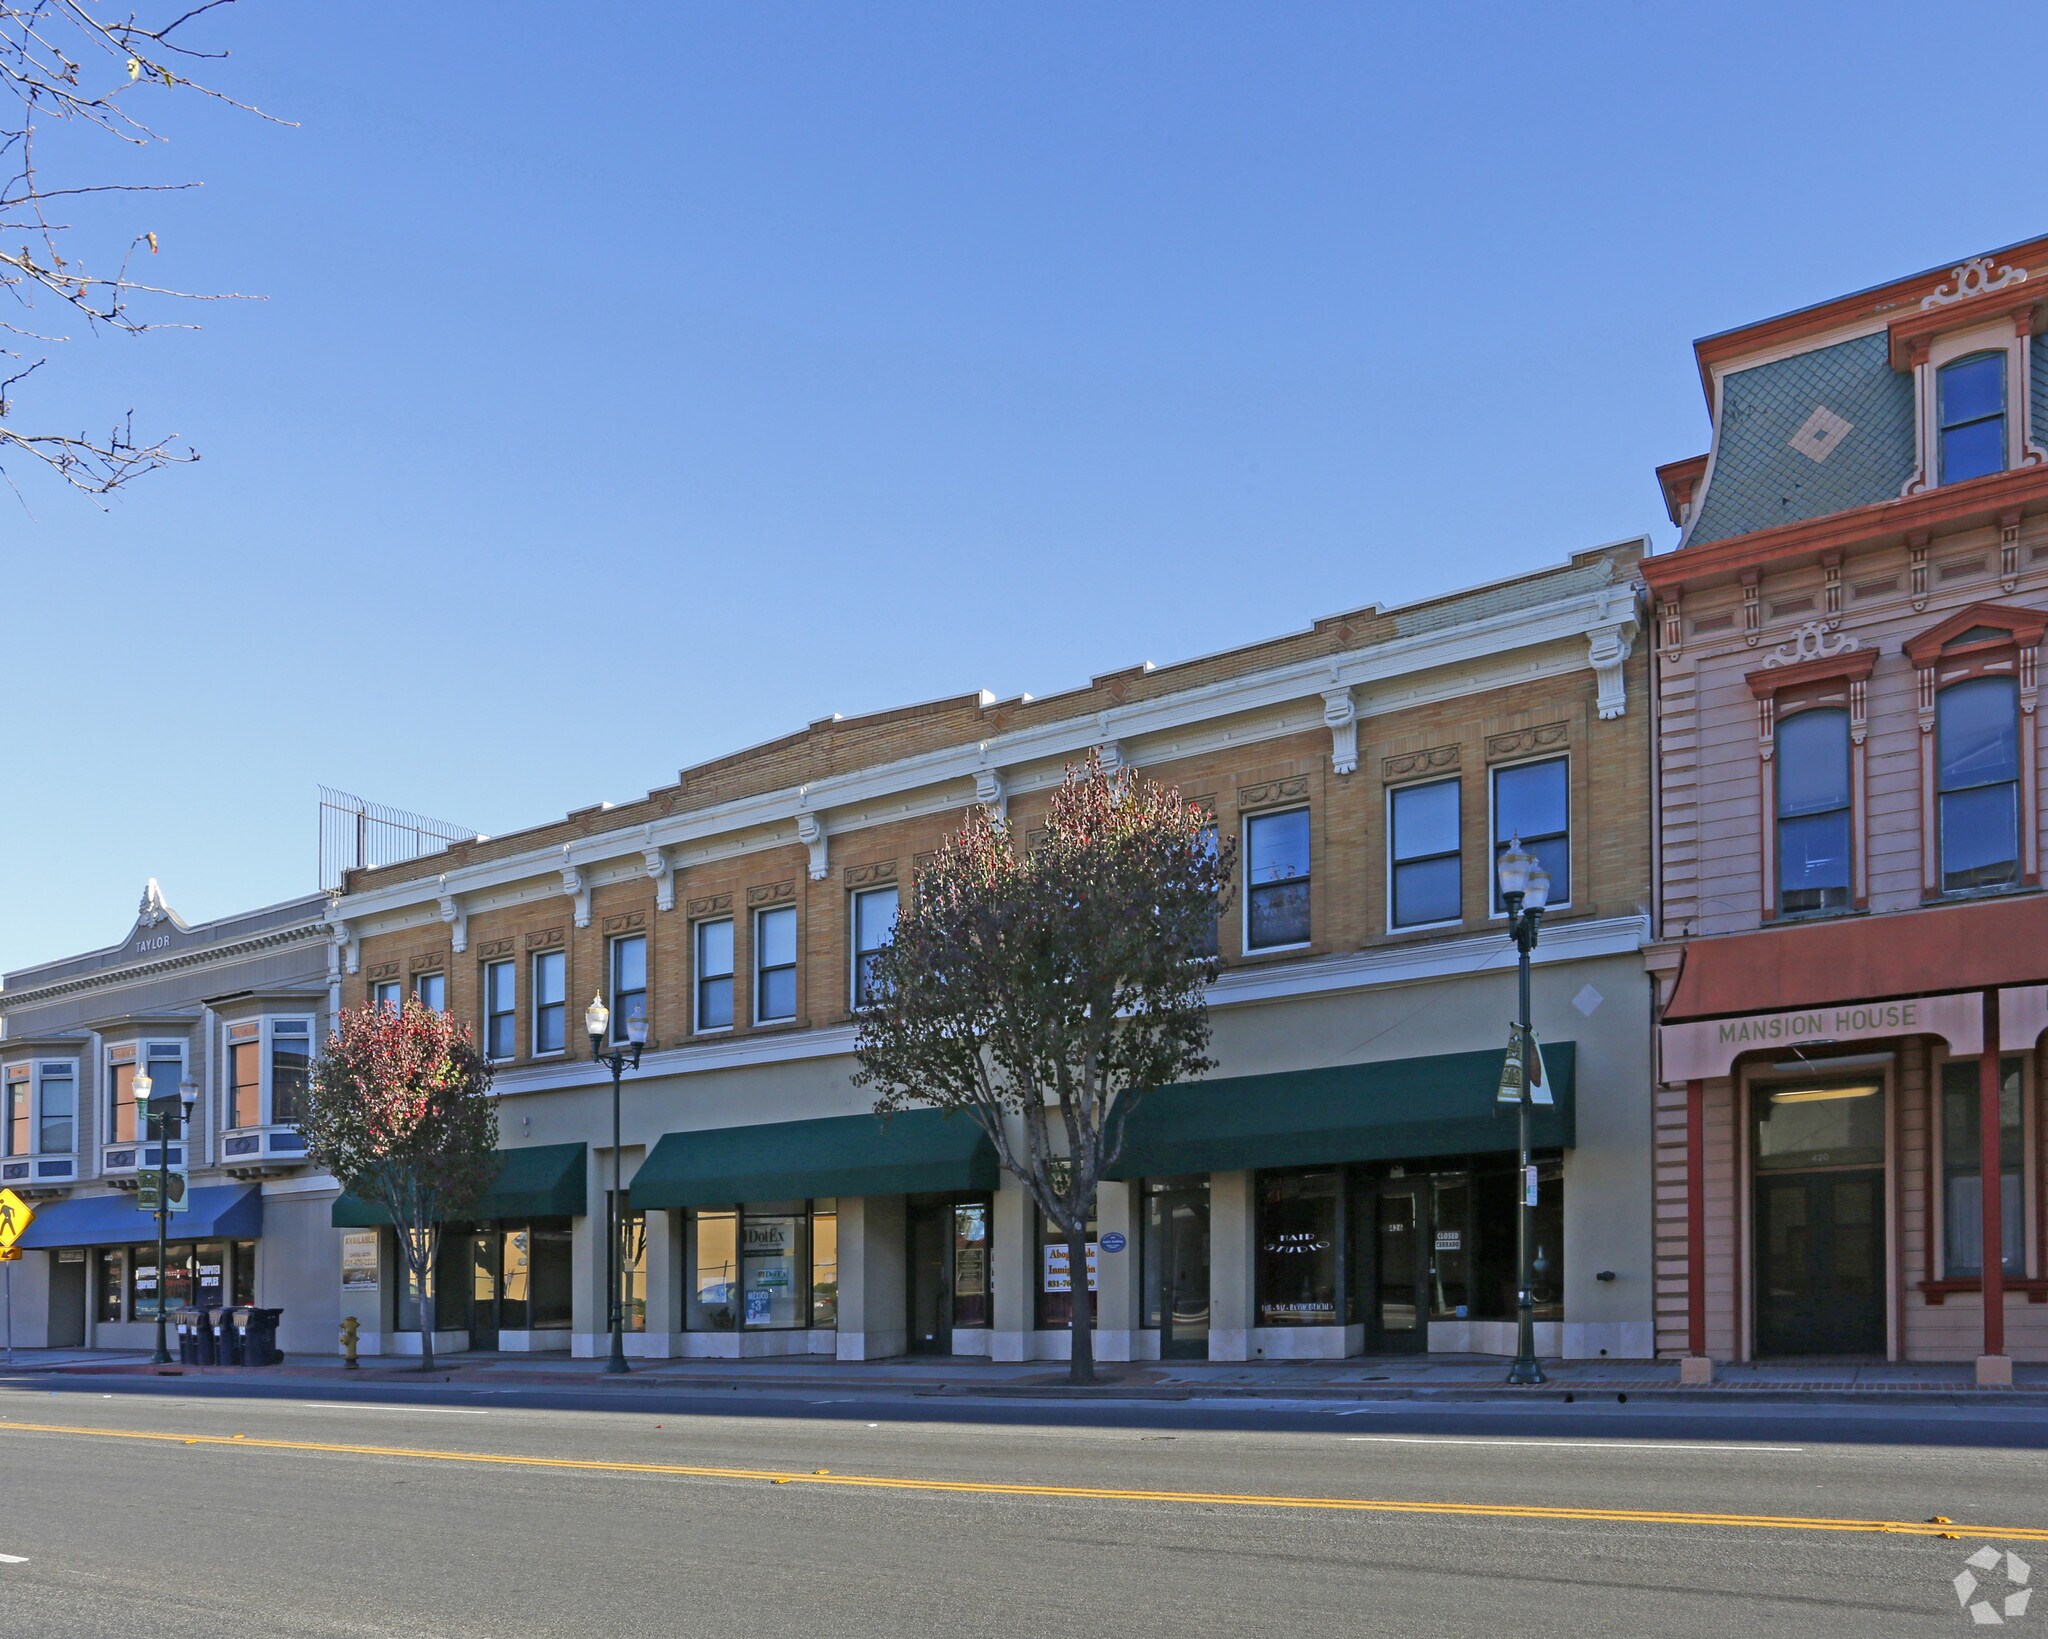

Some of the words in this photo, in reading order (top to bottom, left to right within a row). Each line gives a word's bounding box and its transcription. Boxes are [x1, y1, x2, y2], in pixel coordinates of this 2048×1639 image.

[135, 935, 170, 953] TAYLOR
[1719, 1013, 1823, 1044] MANSION
[1836, 1004, 1917, 1032] HOUSE
[345, 1235, 376, 1244] AVAILABLE
[749, 1227, 785, 1243] DolEx
[1437, 1232, 1459, 1240] CLOSED
[1263, 1241, 1331, 1254] STUDIO
[1049, 1248, 1070, 1261] Abog
